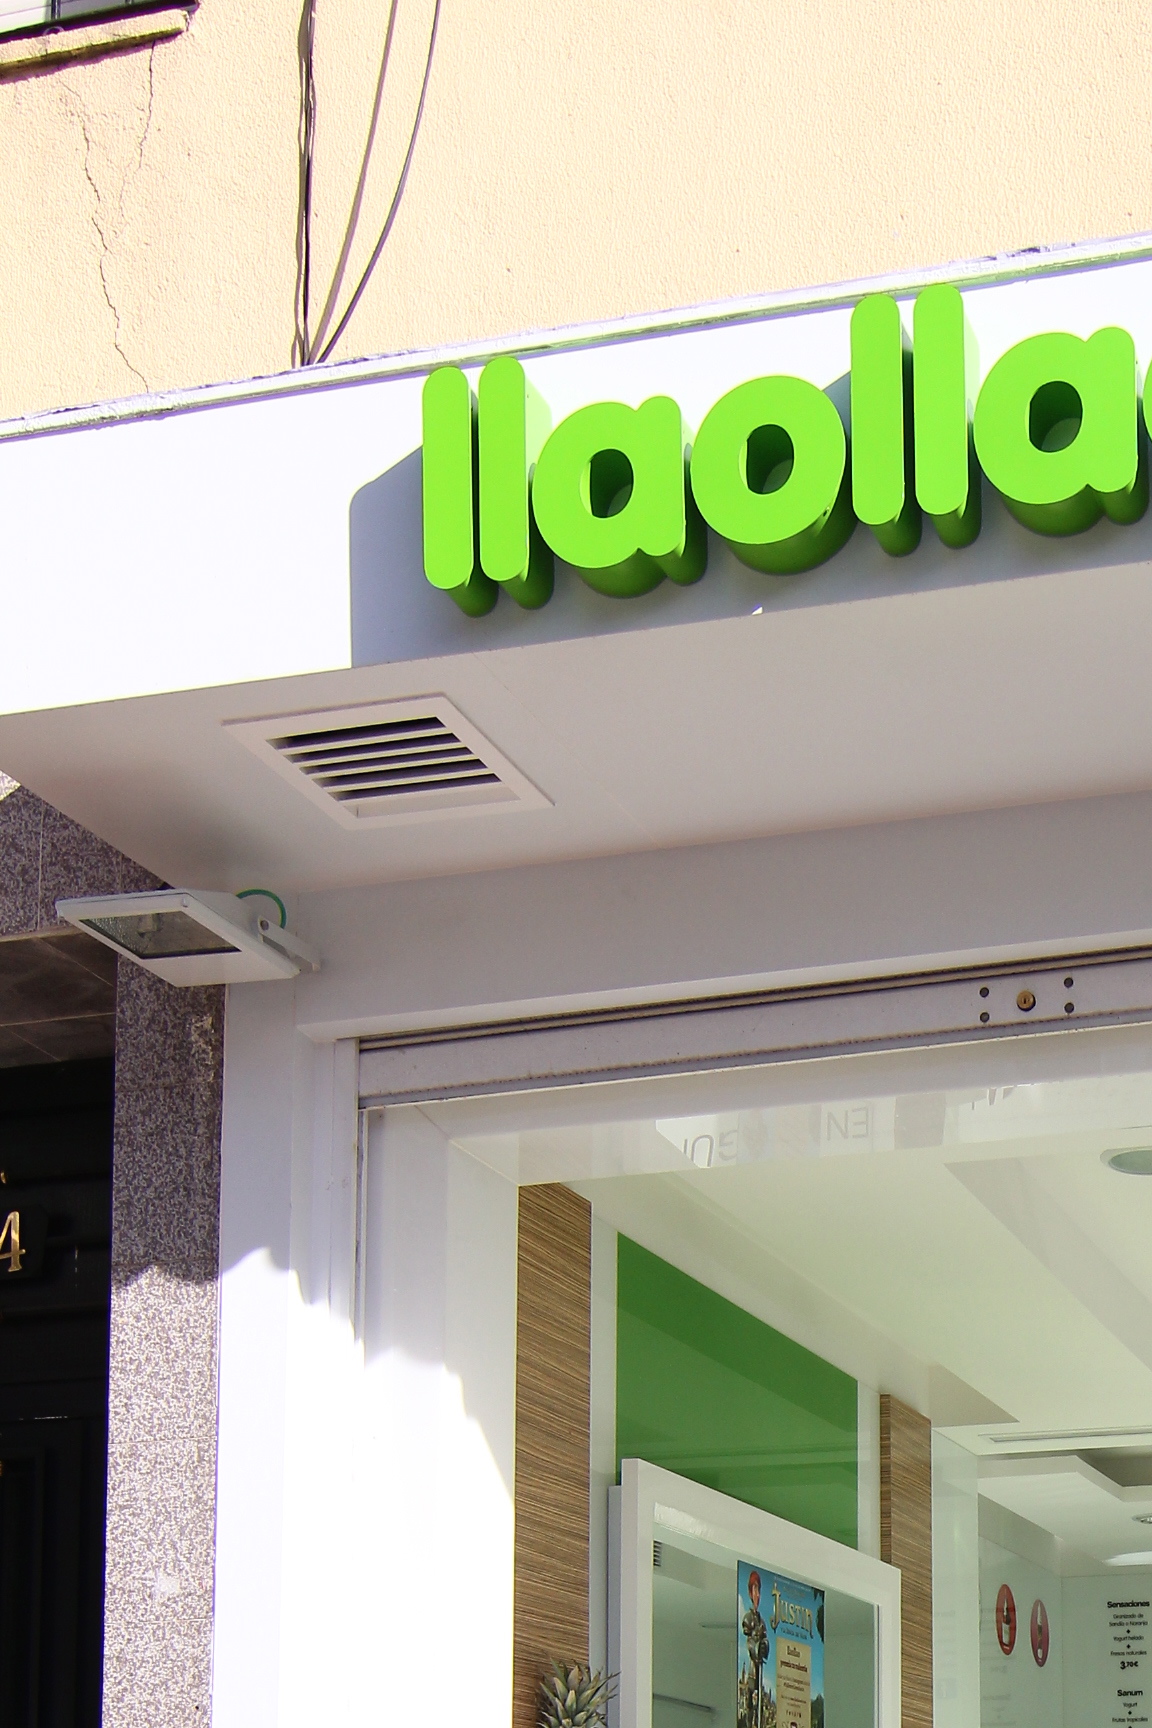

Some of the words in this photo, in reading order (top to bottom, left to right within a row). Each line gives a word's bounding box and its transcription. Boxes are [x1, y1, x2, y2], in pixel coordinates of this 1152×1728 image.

[0, 1211, 26, 1272] 4
[1107, 1600, 1150, 1609] Sensaciones
[1117, 1689, 1143, 1697] Sanum
